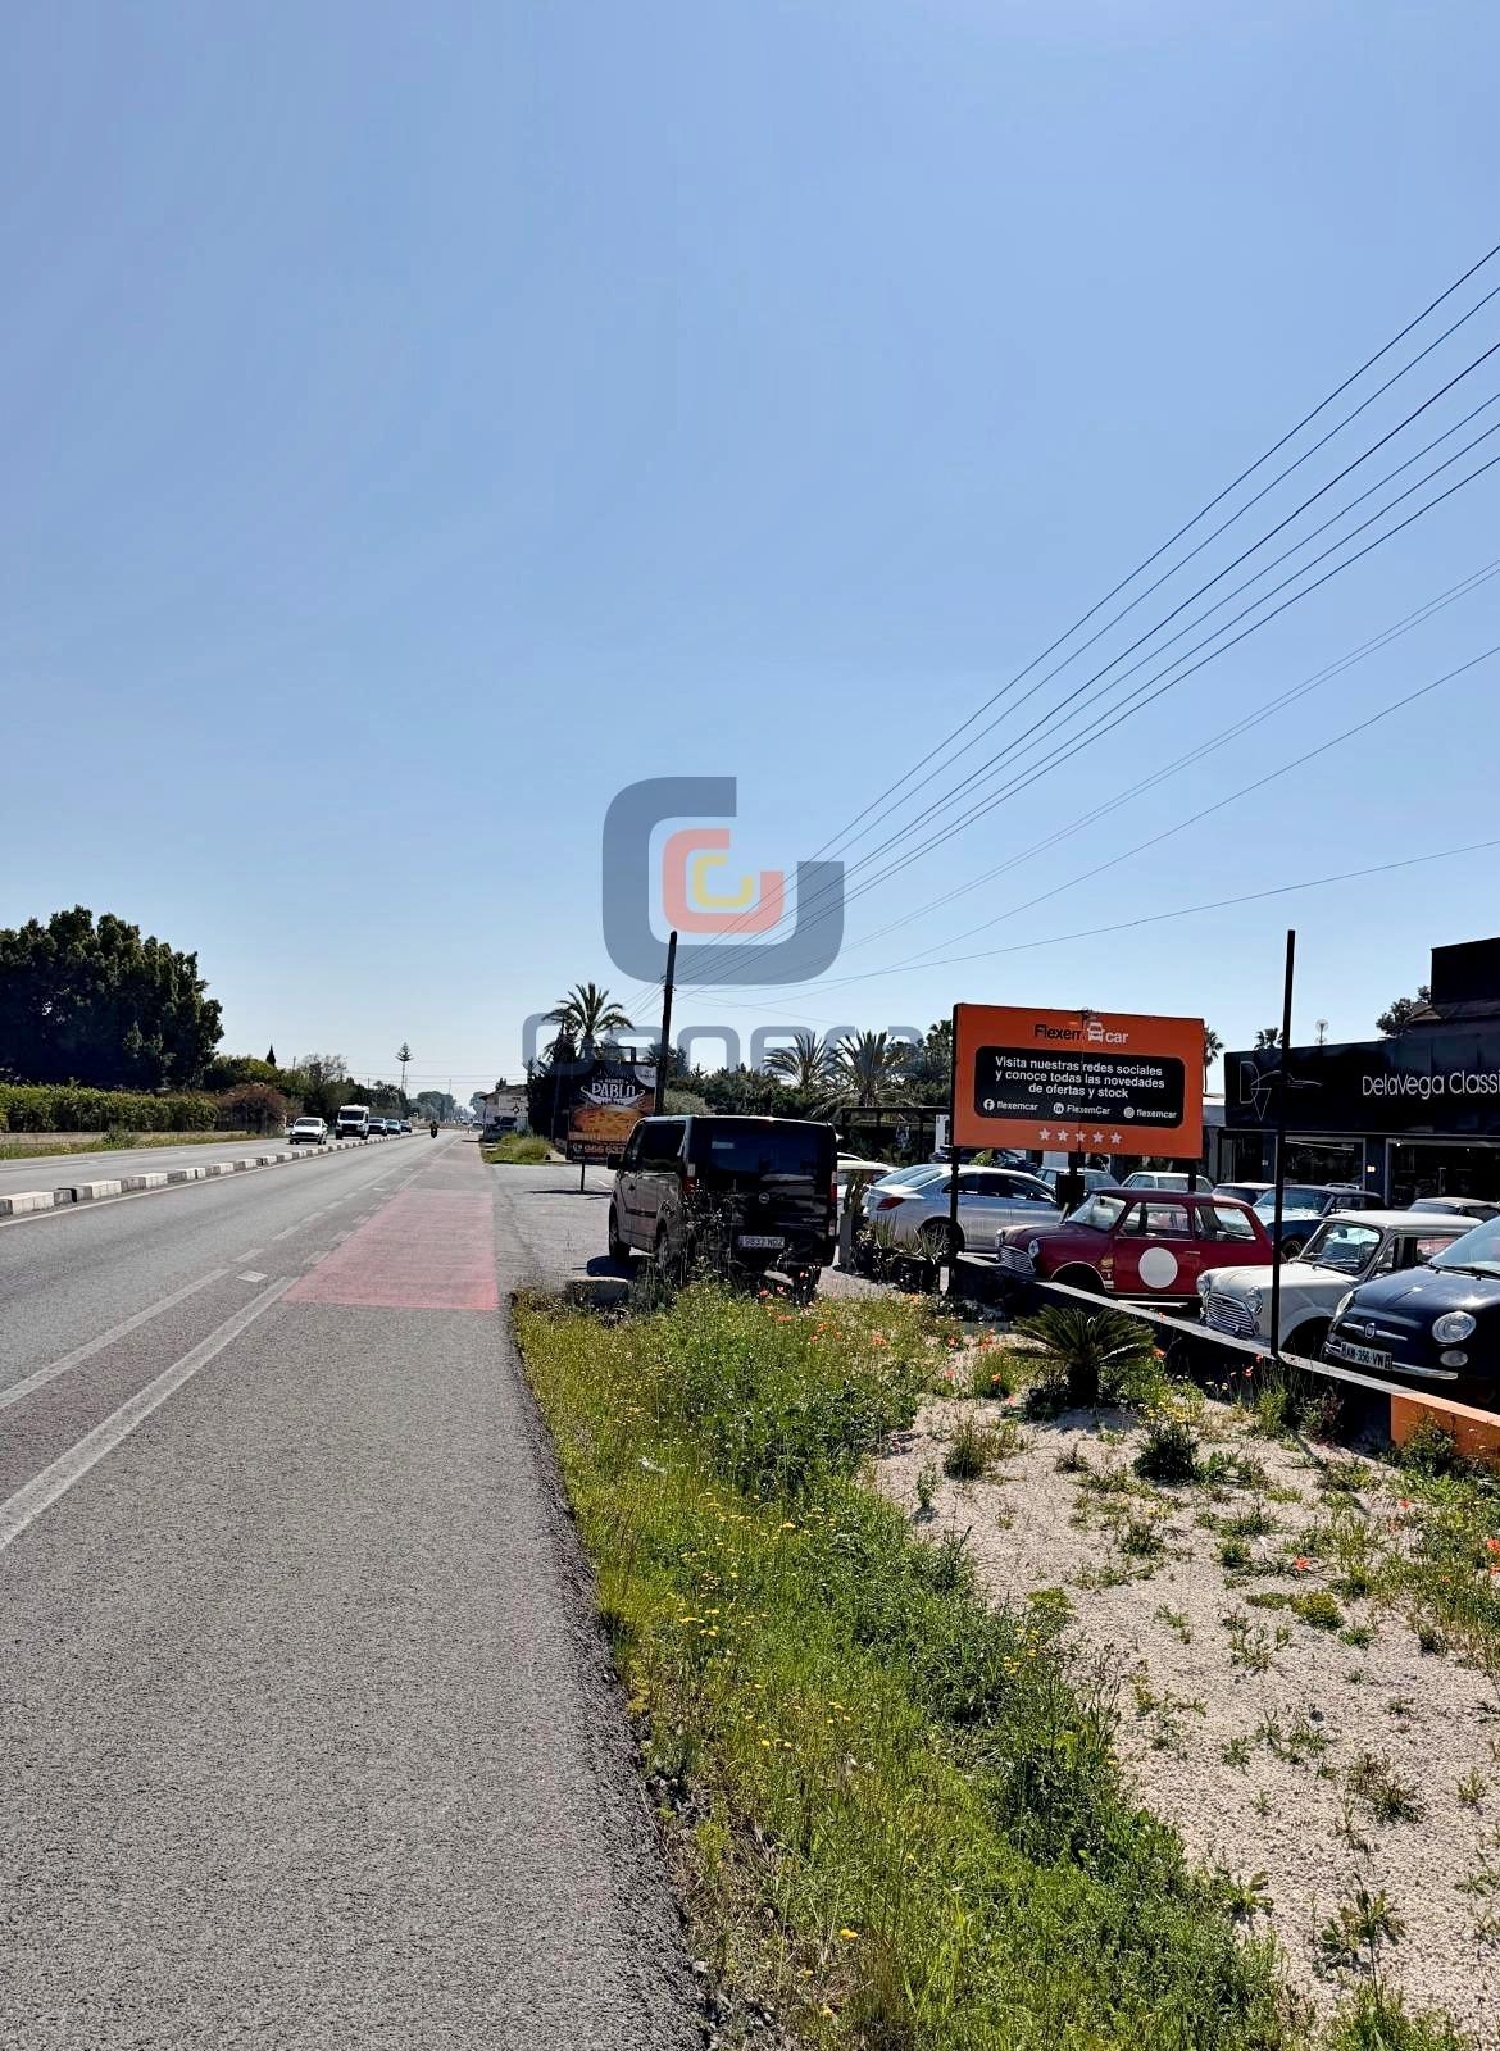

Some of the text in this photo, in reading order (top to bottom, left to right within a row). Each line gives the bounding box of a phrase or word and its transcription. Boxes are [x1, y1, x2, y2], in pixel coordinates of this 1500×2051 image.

[995, 1055, 1163, 1077] Visita nuestras redes sociales
[994, 1070, 1165, 1089] y conoce todas las novedades
[1362, 1073, 1445, 1100] DelaVega
[1028, 1082, 1129, 1099] de ofertas y stock
[996, 1100, 1039, 1112] flexemcar
